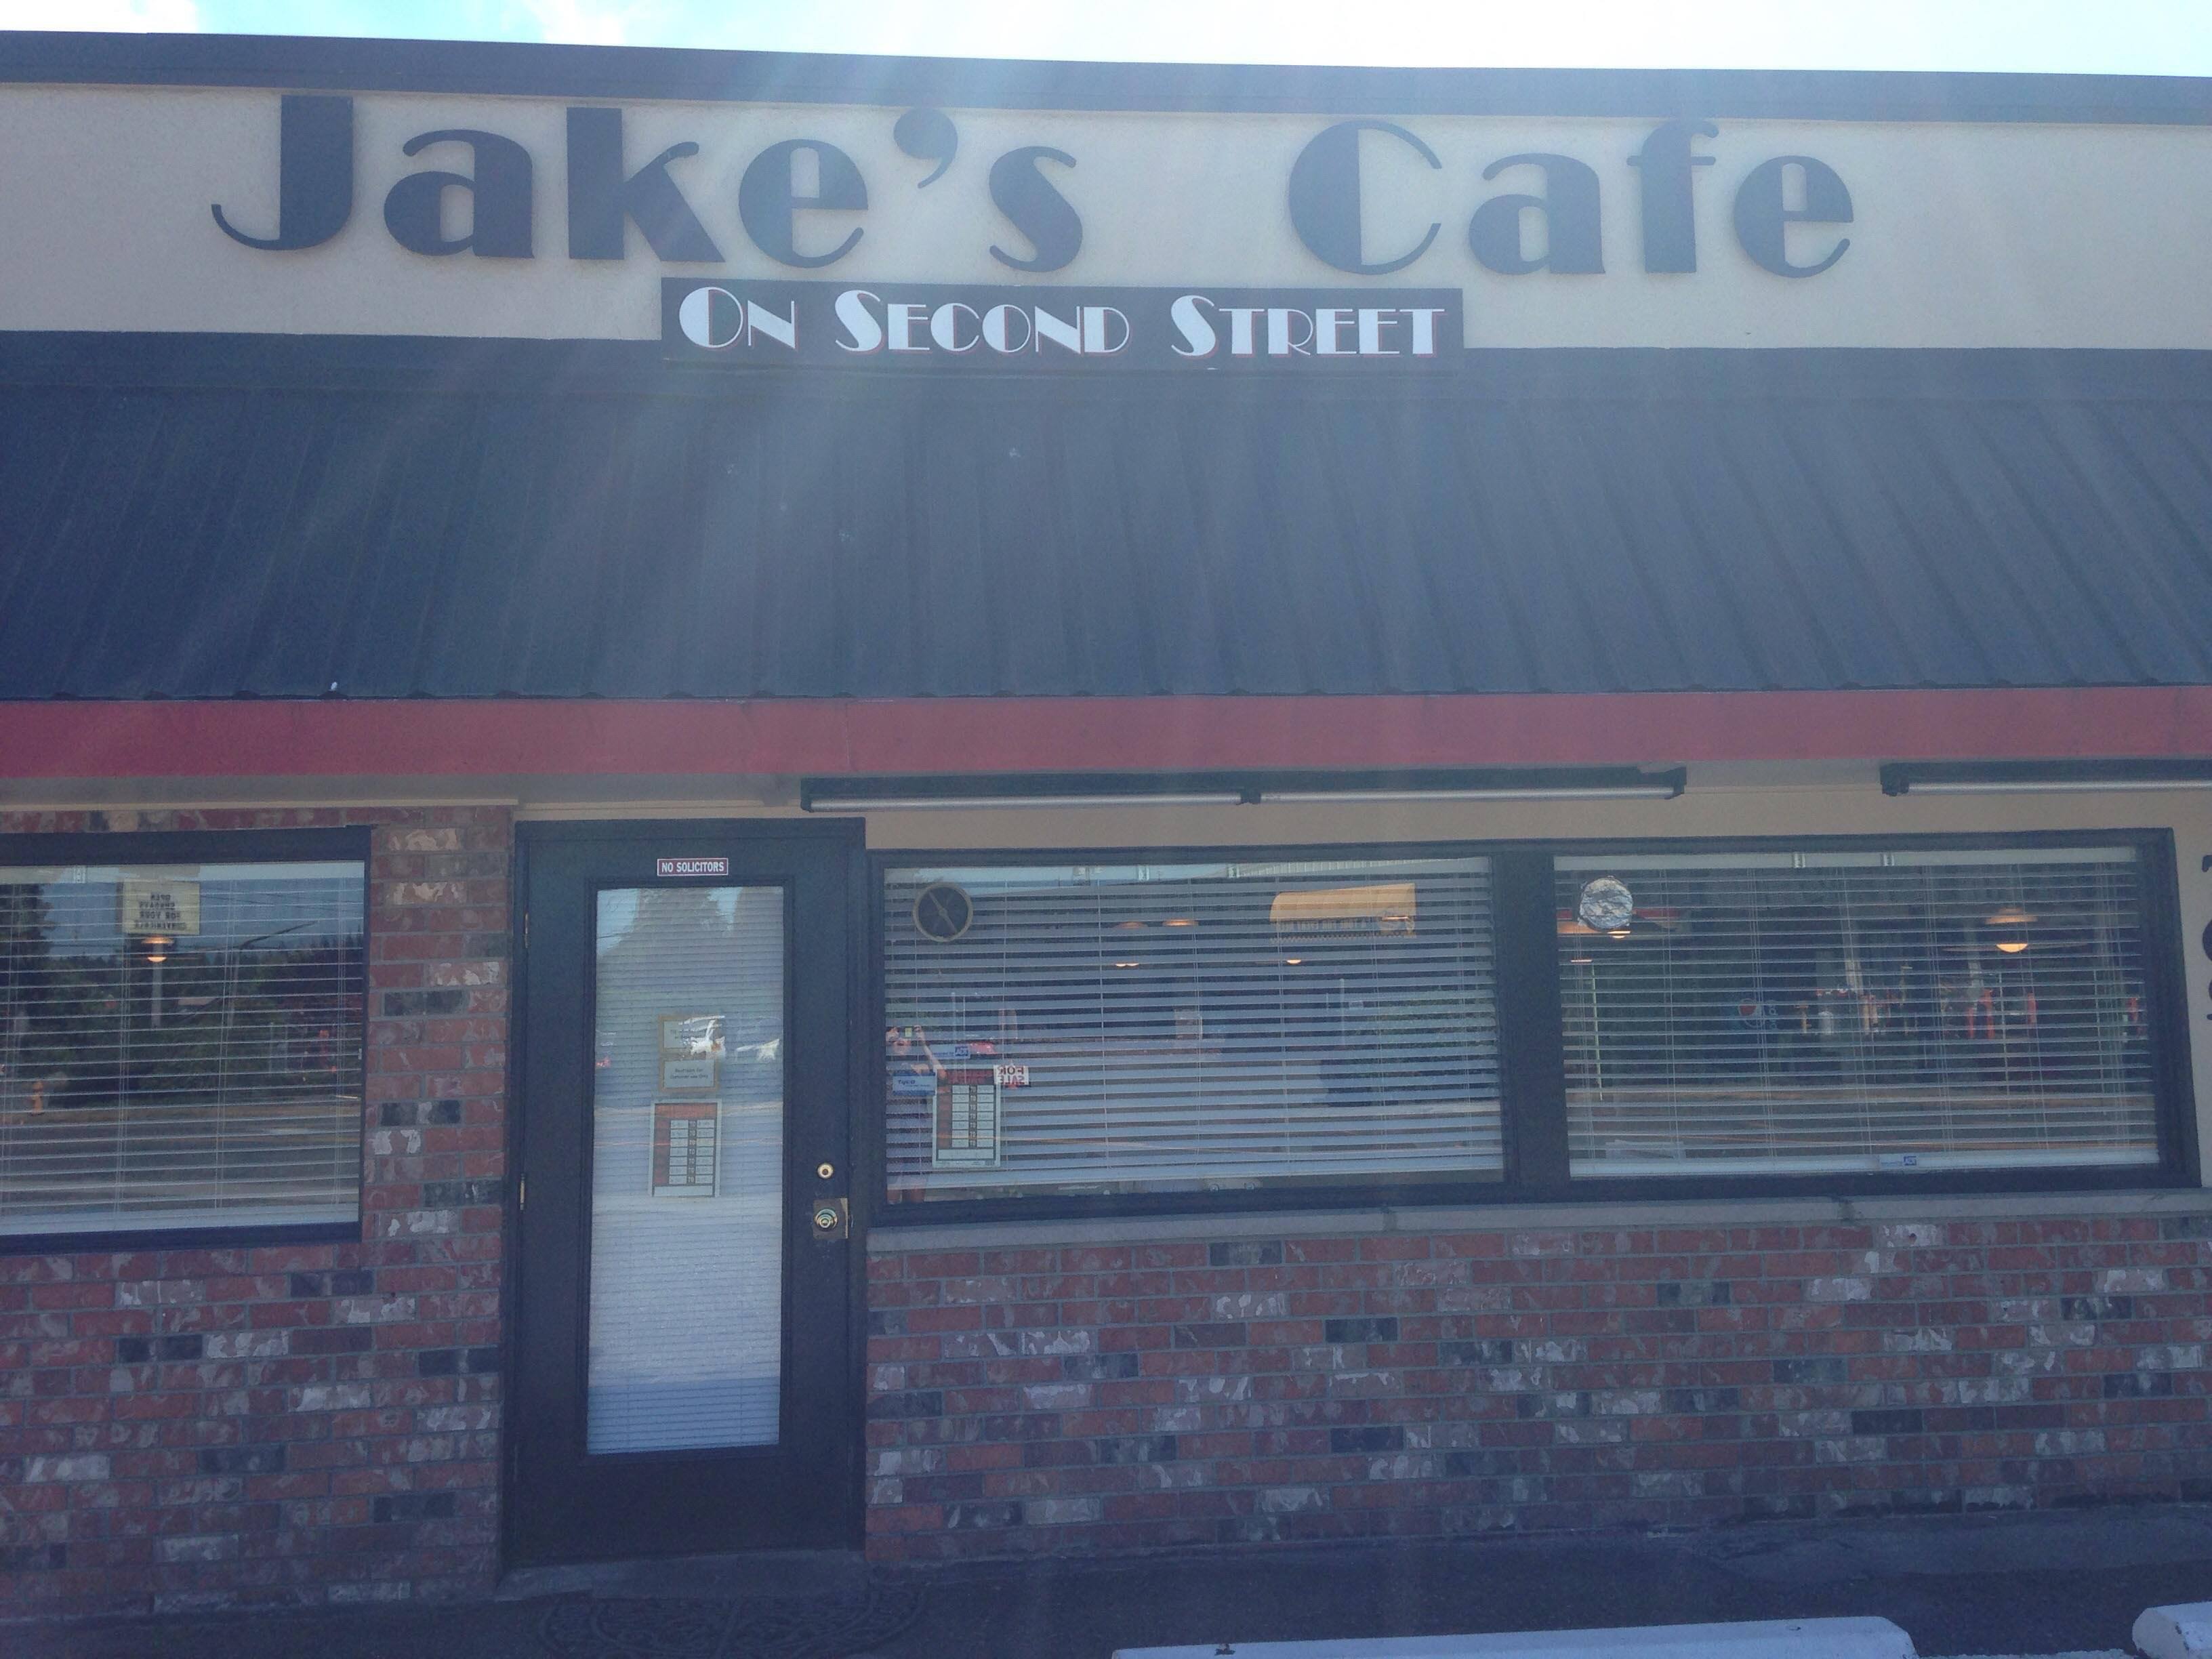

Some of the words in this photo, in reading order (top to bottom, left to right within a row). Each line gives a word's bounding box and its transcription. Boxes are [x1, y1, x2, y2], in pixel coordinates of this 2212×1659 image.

[211, 95, 1083, 272] Jake's
[1288, 118, 1853, 279] Cafe
[678, 286, 797, 350] ON
[834, 289, 1131, 356] SECOND
[1170, 295, 1446, 357] STREET
[661, 862, 674, 873] NO
[676, 861, 724, 873] SOLICITORS
